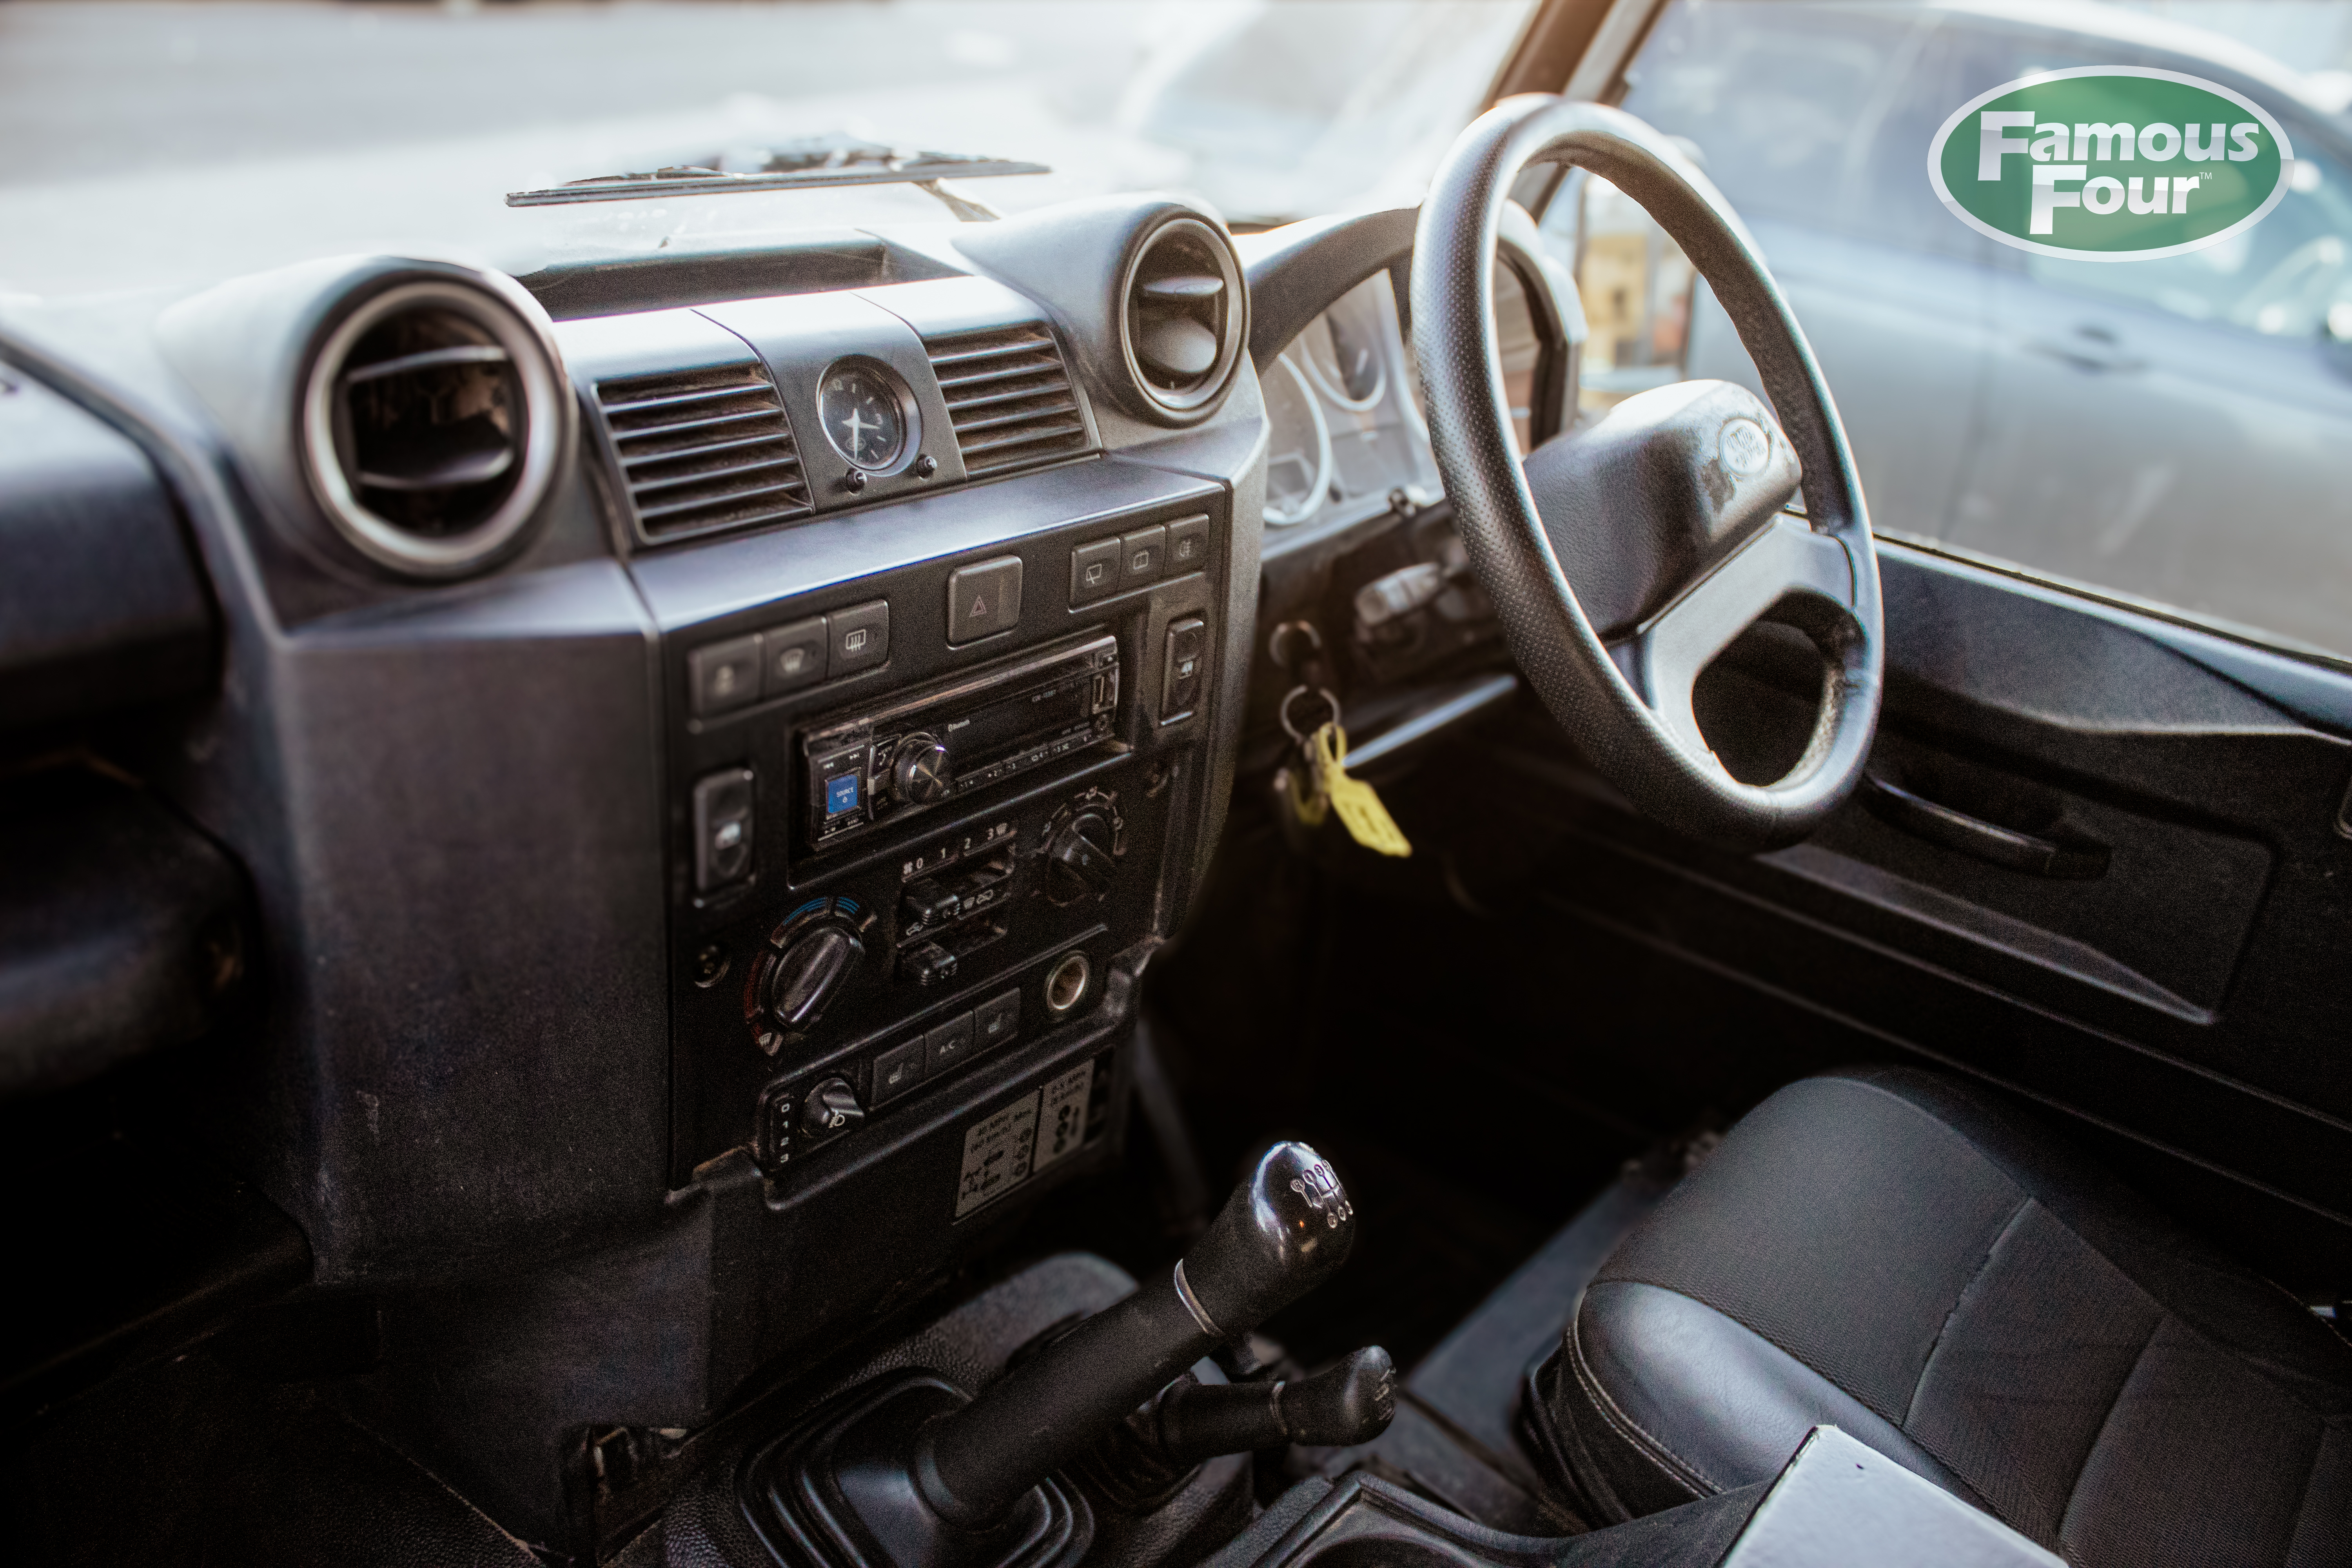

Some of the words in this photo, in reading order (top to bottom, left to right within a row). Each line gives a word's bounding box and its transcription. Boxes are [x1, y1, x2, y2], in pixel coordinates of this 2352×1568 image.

[916, 857, 924, 869] 0
[940, 847, 946, 858] 1
[964, 837, 971, 849] 2
[986, 828, 994, 840] 3
[781, 1103, 790, 1113] 0
[782, 1120, 789, 1129] 1
[780, 1136, 789, 1147] 2
[780, 1153, 789, 1163] 3
[1316, 1166, 1321, 1175] 3
[1294, 1180, 1303, 1190] R
